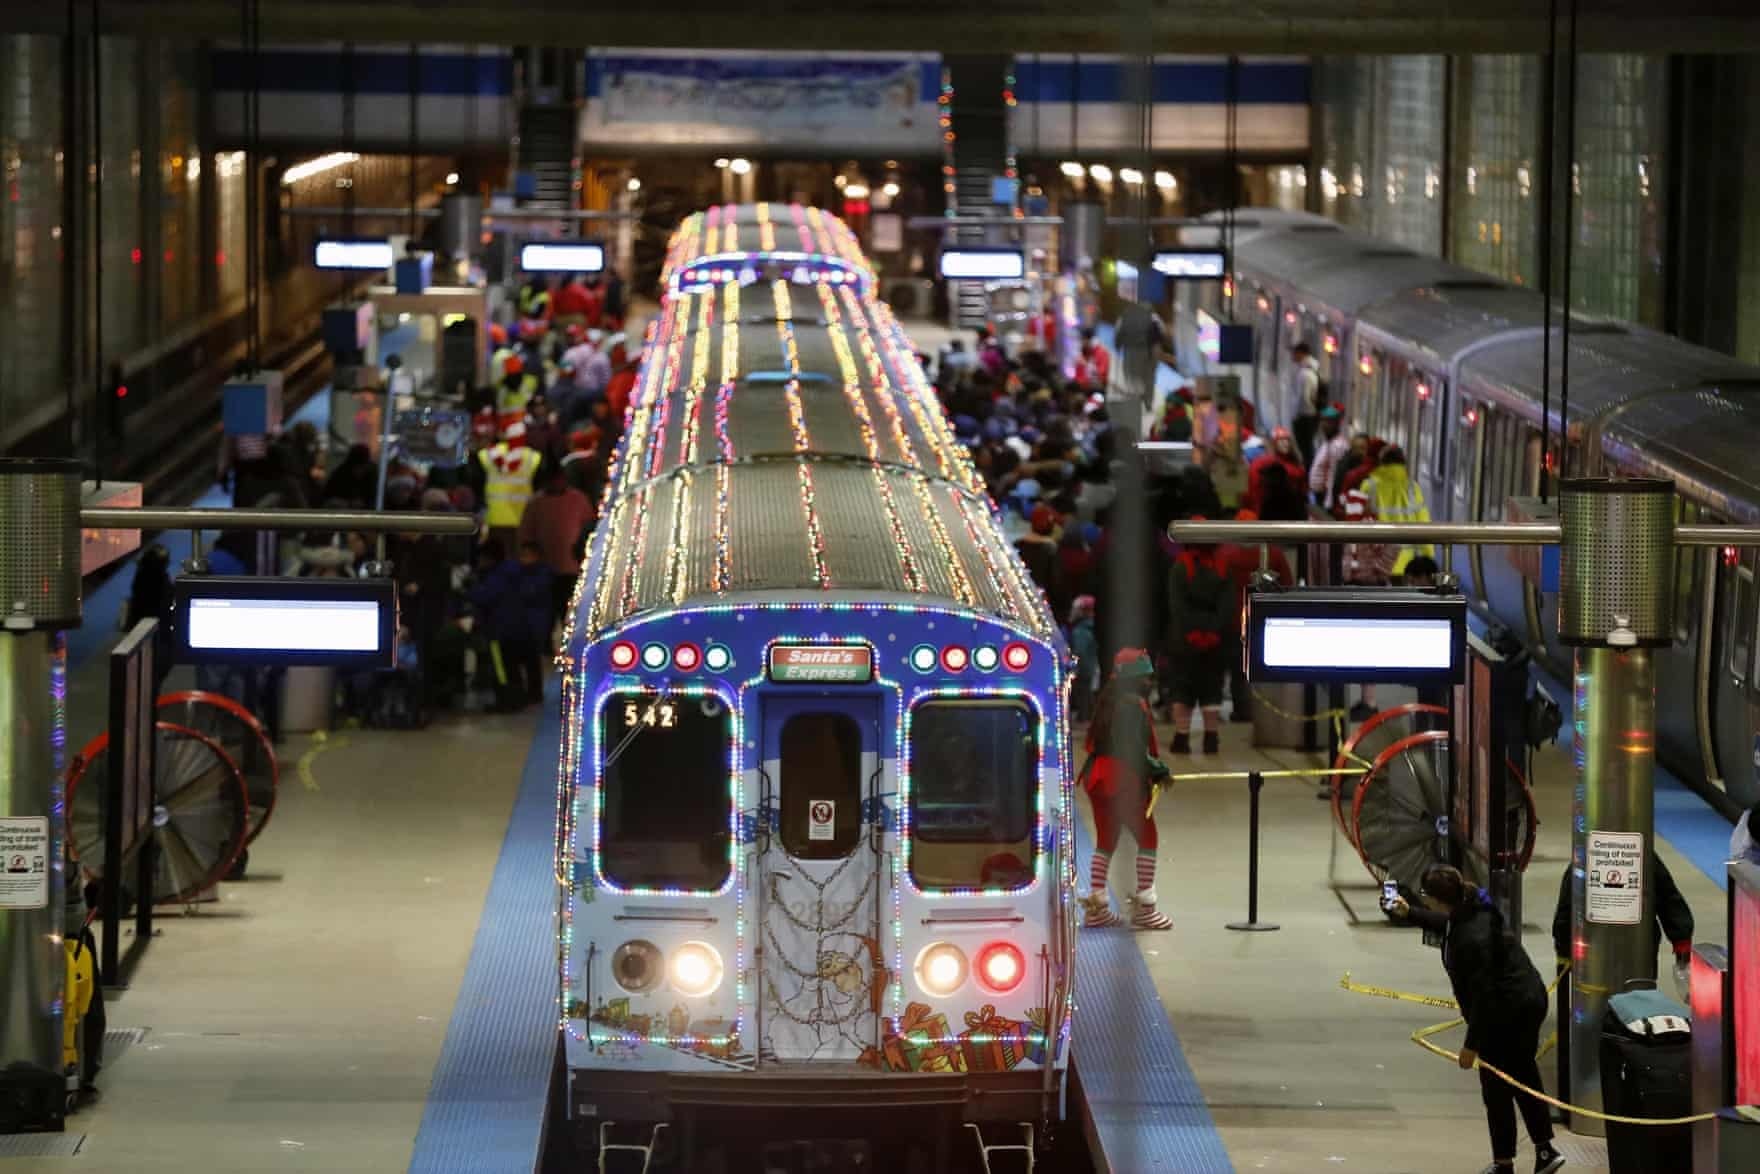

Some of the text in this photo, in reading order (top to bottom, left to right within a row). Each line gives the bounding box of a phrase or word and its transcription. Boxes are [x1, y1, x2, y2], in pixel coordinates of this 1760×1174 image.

[788, 650, 854, 664] Santa's
[785, 665, 857, 680] Express
[624, 704, 673, 726] 542
[1596, 858, 1634, 867] prohibited
